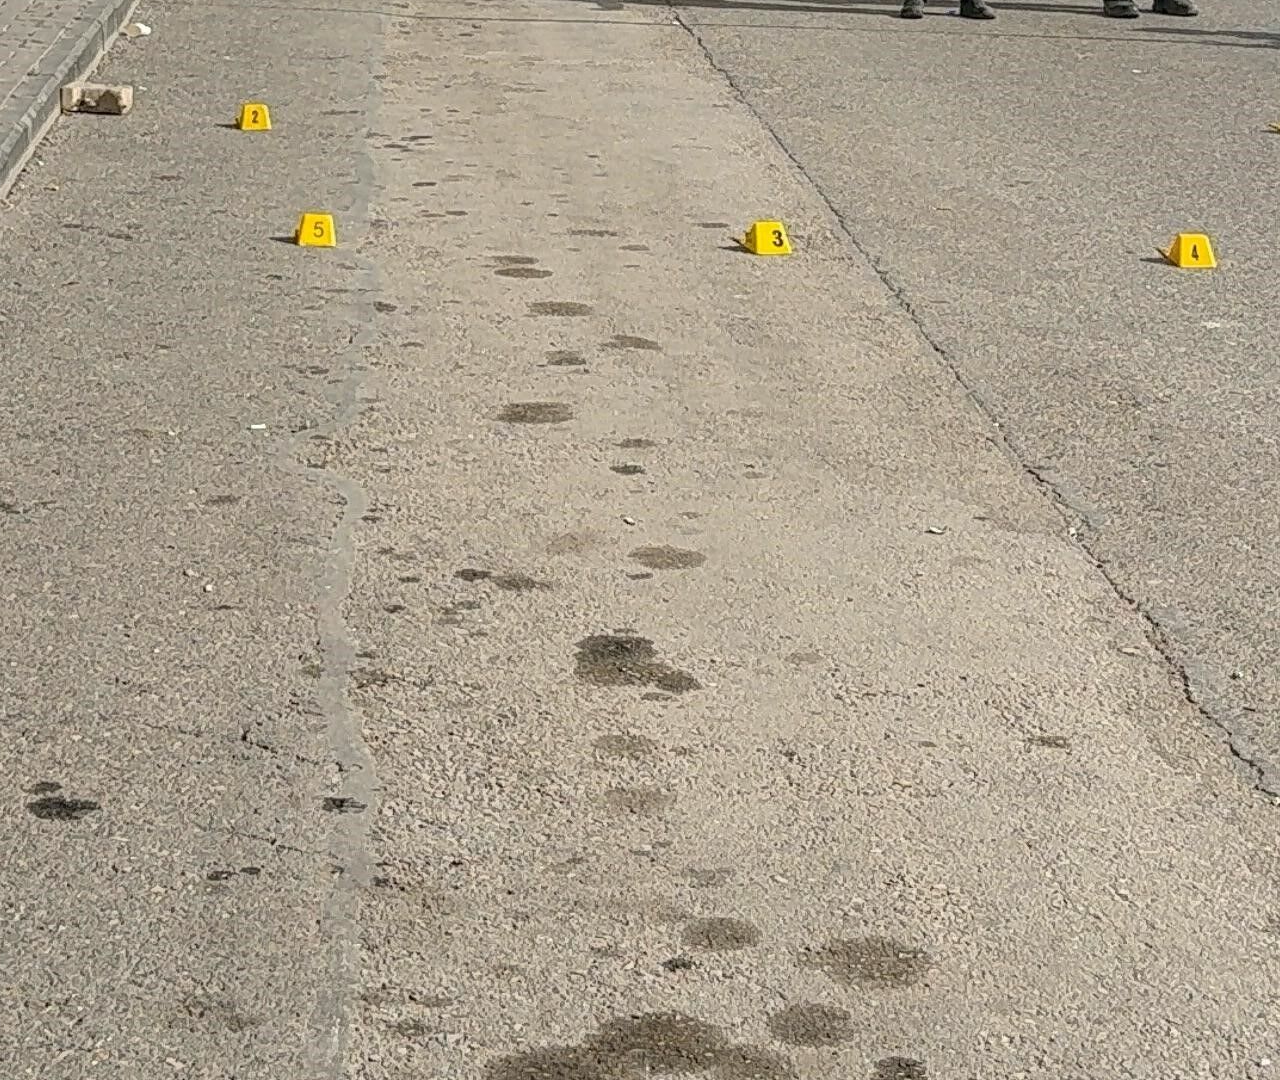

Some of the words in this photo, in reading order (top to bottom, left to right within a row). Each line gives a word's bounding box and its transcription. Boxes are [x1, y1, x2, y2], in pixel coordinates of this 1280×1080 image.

[251, 110, 259, 124] 2
[313, 221, 324, 238] 5
[772, 230, 784, 247] 3
[1191, 244, 1200, 261] 4
